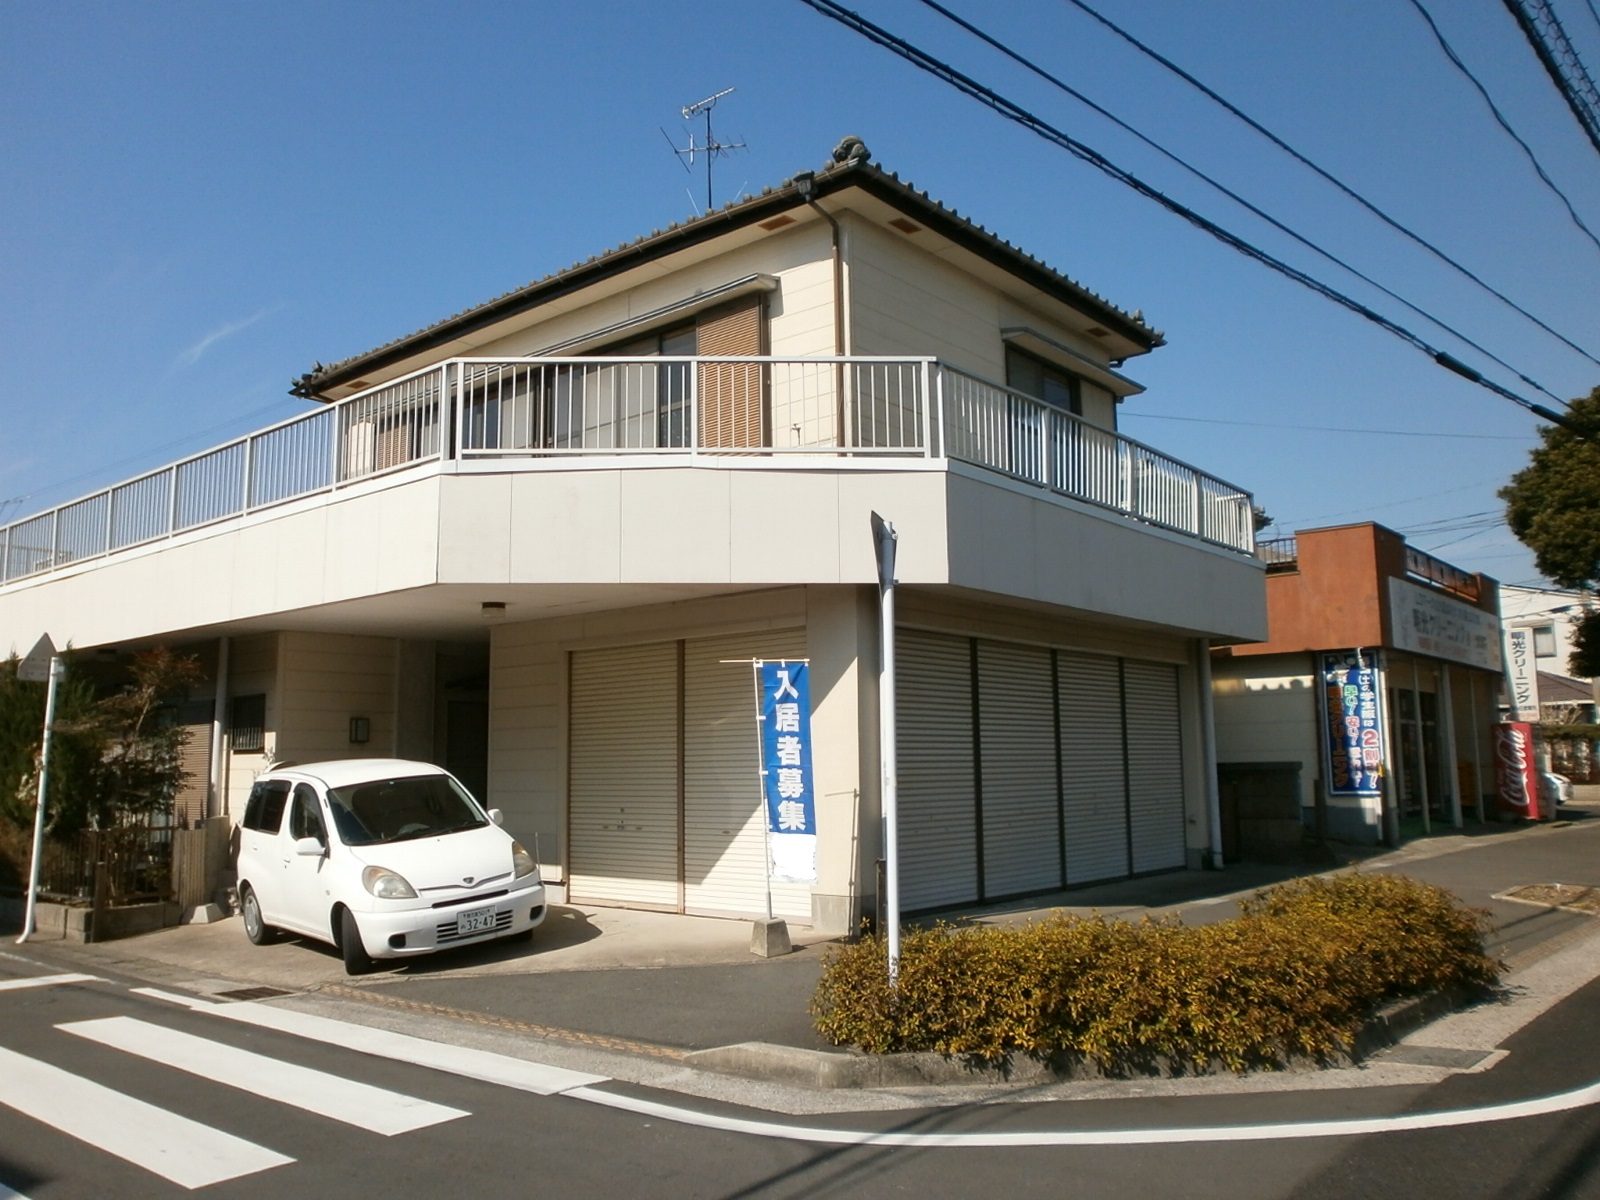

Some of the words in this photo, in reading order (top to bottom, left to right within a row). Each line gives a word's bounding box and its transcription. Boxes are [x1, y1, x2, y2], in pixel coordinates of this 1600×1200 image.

[1511, 631, 1530, 704] 明光クリーニング
[773, 670, 807, 831] 入居者募集
